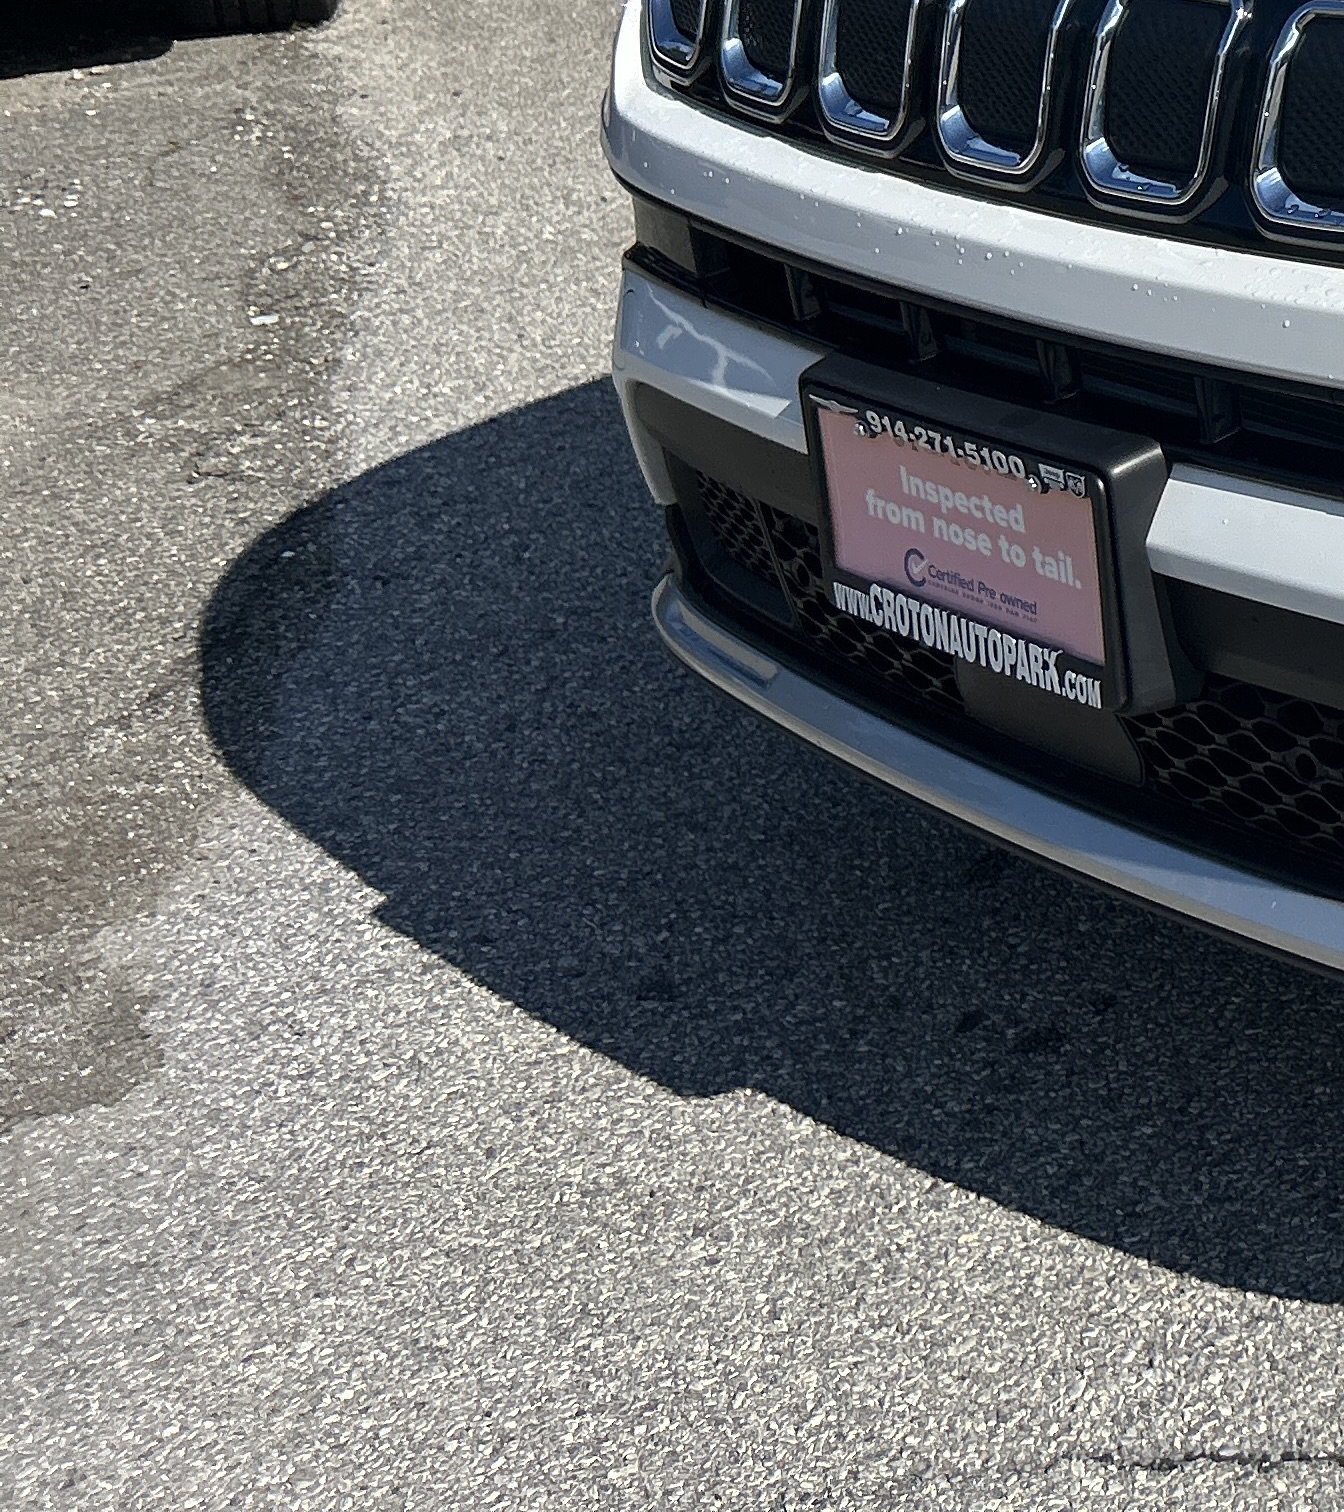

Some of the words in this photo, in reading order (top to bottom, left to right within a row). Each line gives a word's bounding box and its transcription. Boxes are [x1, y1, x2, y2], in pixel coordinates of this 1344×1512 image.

[899, 464, 1026, 533] Inspected
[865, 488, 925, 534] from
[932, 516, 993, 557] nose
[998, 535, 1027, 568] to
[1032, 545, 1082, 589] tail.
[928, 564, 975, 593] Certified
